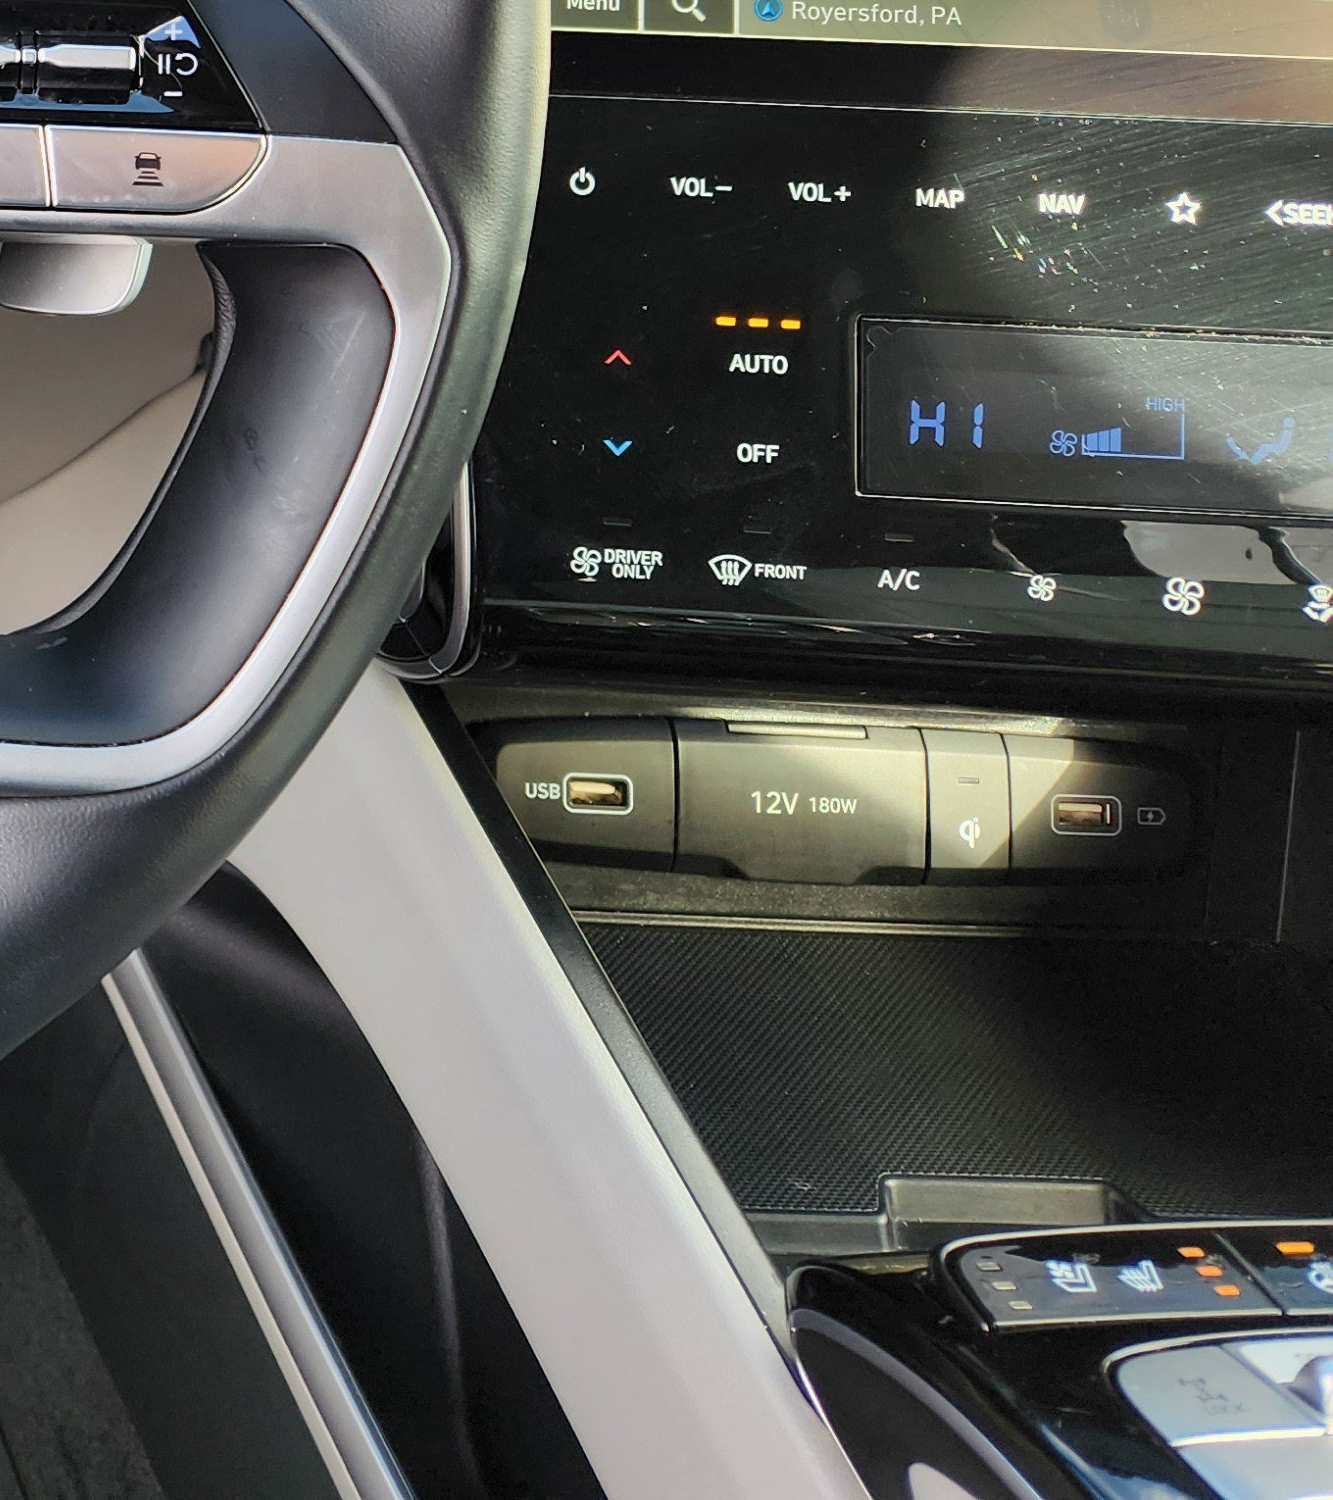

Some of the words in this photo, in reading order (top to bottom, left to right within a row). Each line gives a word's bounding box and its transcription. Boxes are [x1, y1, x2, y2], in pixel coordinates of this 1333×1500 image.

[792, 2, 926, 30] Royersford,
[932, 7, 962, 26] PA
[915, 189, 965, 208] MAP
[1039, 194, 1085, 216] NAV
[730, 354, 789, 376] AUTO
[1146, 397, 1185, 412] HIGH
[737, 443, 780, 464] OFF
[604, 549, 663, 568] DRIVER
[613, 565, 654, 581] ONLY
[755, 564, 807, 581] FRONT
[878, 569, 921, 591] A/C
[525, 782, 561, 800] USB
[750, 791, 799, 815] 12V
[809, 797, 858, 814] 180W
